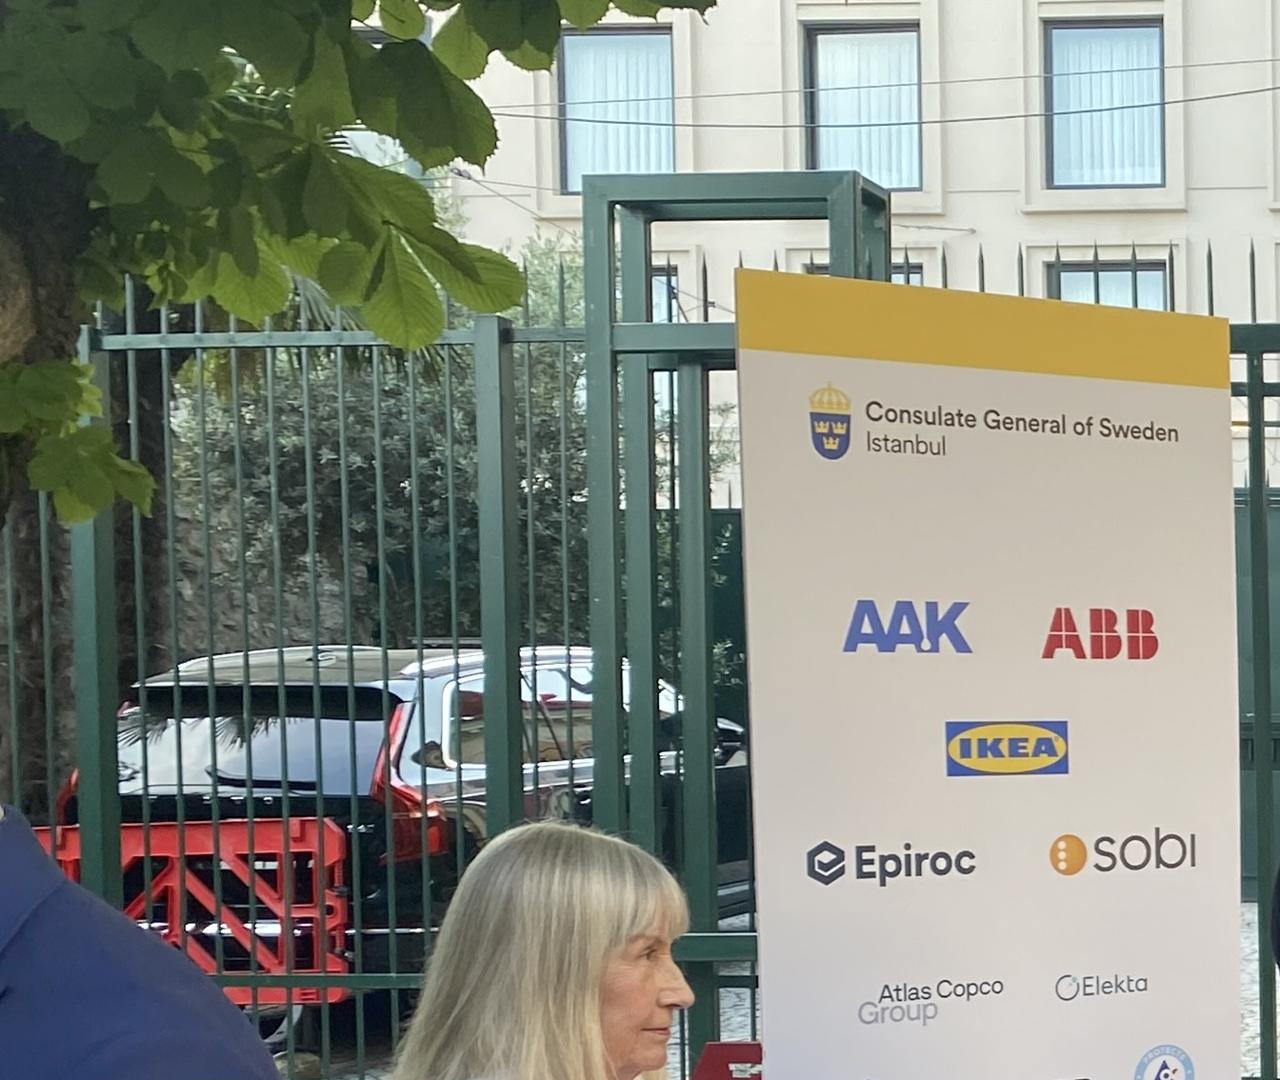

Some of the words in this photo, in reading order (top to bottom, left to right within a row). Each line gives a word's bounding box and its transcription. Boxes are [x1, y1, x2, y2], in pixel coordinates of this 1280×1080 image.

[865, 400, 977, 429] Consulate
[983, 409, 1066, 435] General
[1072, 416, 1094, 437] of
[1099, 417, 1179, 443] Sweden
[866, 430, 946, 456] Istanbul
[842, 599, 974, 654] AAK
[1041, 607, 1159, 660] ABB
[959, 737, 1060, 759] IKEA
[855, 842, 977, 888] Epiroc
[1093, 826, 1197, 873] sobi
[878, 982, 932, 1003] Atlas
[936, 979, 1004, 1002] Copco
[1082, 974, 1148, 997] Elekta
[857, 1000, 938, 1026] Group
